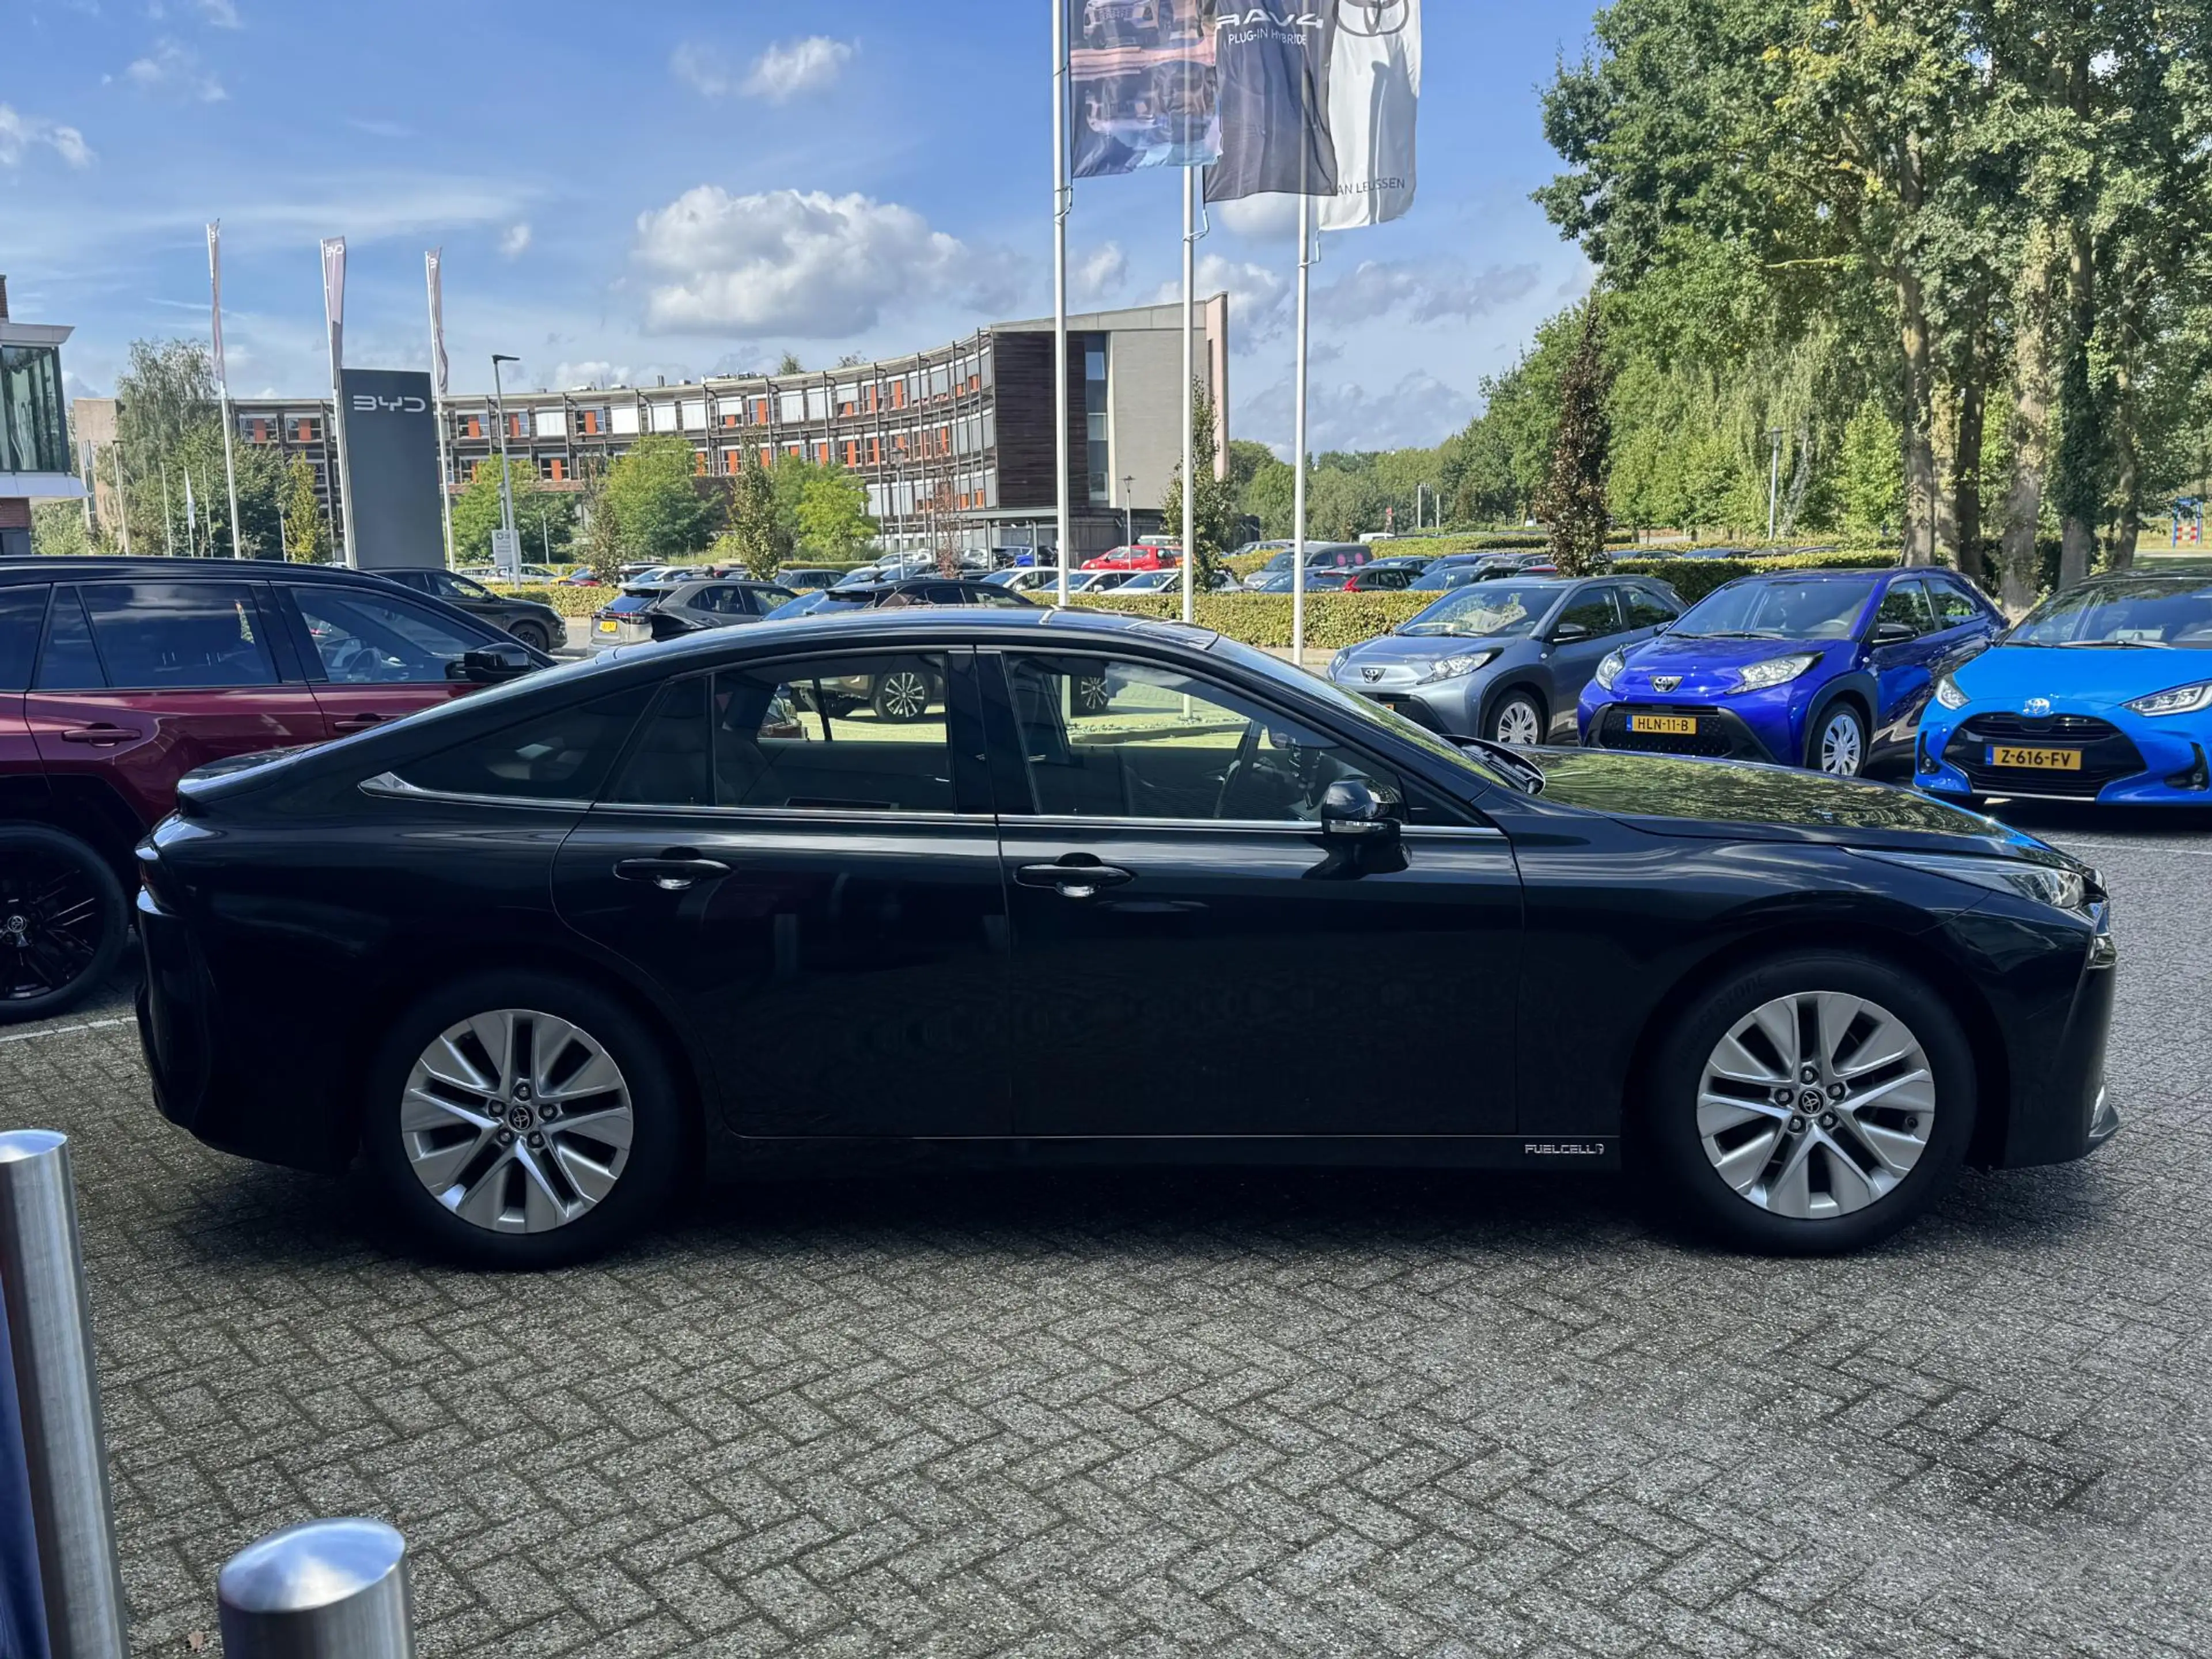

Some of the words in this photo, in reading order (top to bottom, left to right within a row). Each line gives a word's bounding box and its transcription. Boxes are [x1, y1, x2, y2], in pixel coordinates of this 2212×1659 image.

[1216, 9, 1324, 29] RAV4
[1229, 29, 1267, 44] PLUG-IN
[1271, 29, 1307, 45] HYBRIDE
[1336, 184, 1353, 195] AN
[353, 395, 426, 412] BYD
[1638, 718, 1688, 731] HLN-11-B
[2001, 750, 2071, 766] Z-616-FV
[1525, 1145, 1597, 1153] FUELCELL
